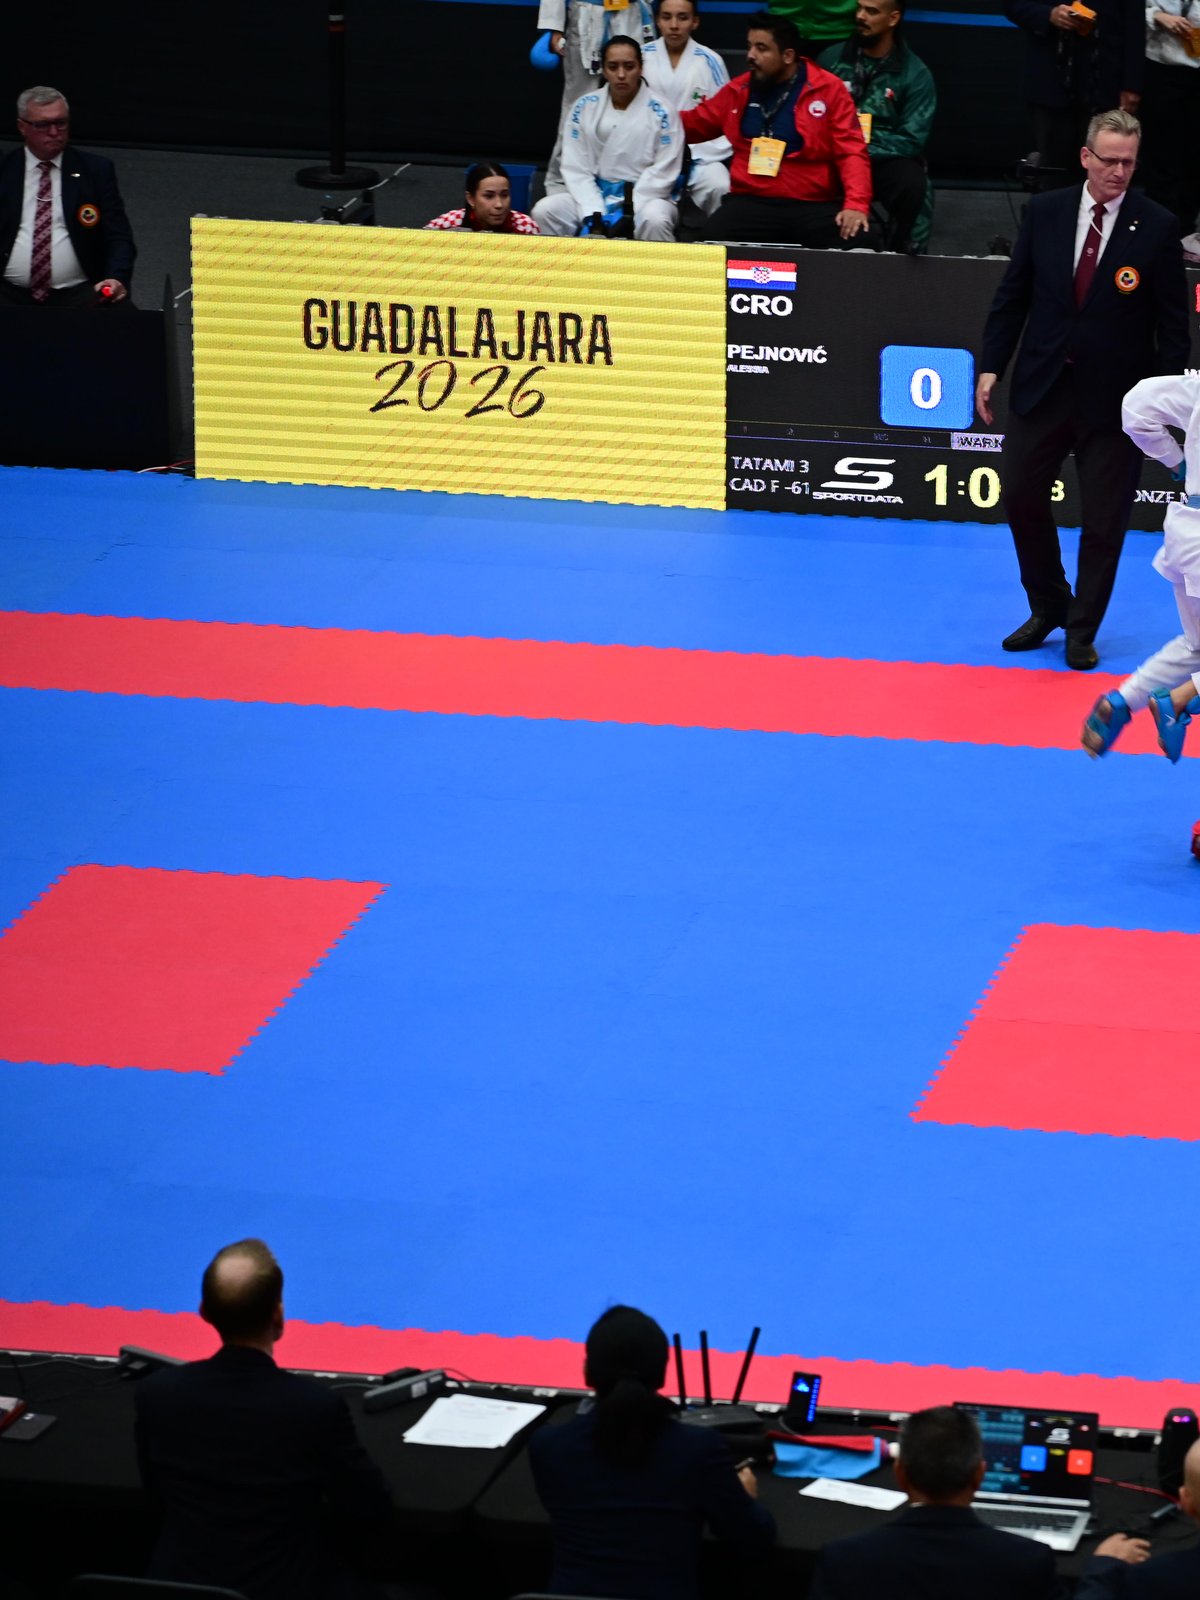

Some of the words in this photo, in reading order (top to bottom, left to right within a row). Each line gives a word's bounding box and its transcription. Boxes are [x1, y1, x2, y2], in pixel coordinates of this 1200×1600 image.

[730, 293, 793, 316] CRO
[303, 298, 614, 366] GUADALAJARA
[727, 344, 828, 364] PEJNOVIĆ
[369, 359, 547, 419] 2026
[910, 367, 943, 410] 0
[731, 456, 795, 472] TATAMI
[799, 459, 810, 474] 3
[729, 477, 766, 493] CAD
[770, 479, 780, 493] F
[784, 481, 810, 495] -61
[812, 491, 904, 504] SPORTDATA
